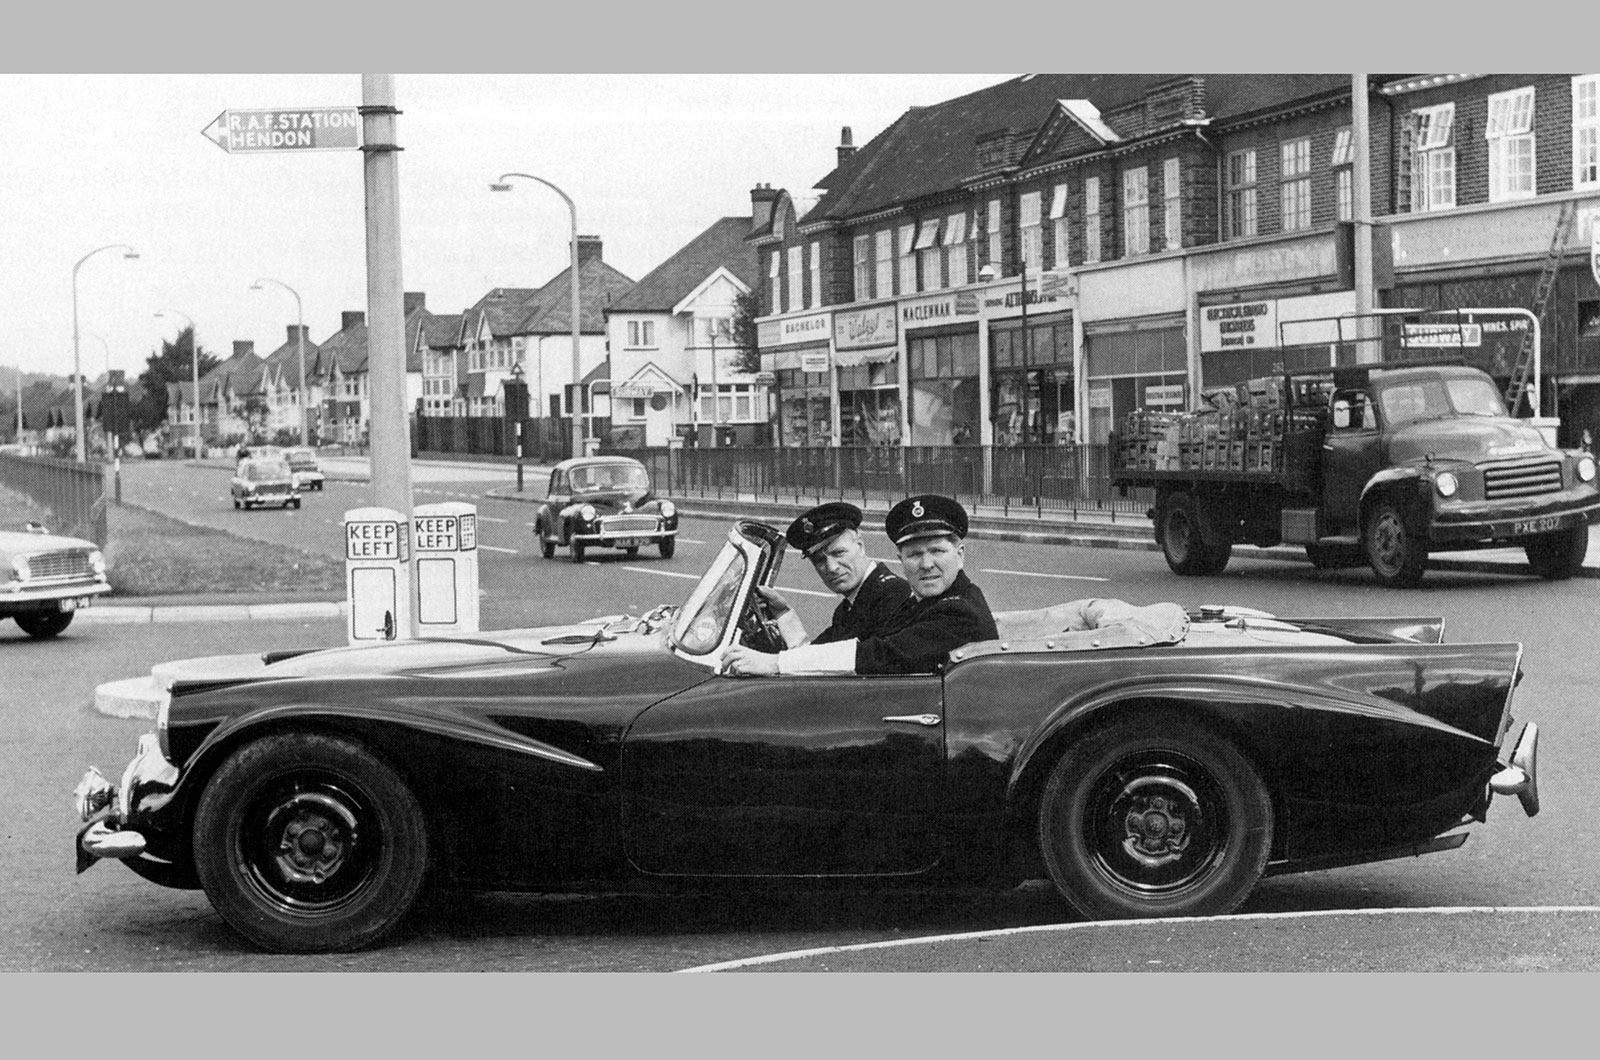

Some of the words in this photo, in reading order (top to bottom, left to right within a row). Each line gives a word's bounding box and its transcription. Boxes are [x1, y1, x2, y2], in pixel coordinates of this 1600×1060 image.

[231, 130, 311, 147] HENDON
[785, 318, 826, 334] BACHELOR
[1406, 327, 1472, 343] SUBWAY
[350, 525, 395, 539] KEEP
[416, 519, 455, 533] KEEP
[1514, 520, 1538, 535] PXE
[352, 541, 393, 556] LEFT
[418, 535, 454, 548] LEFT
